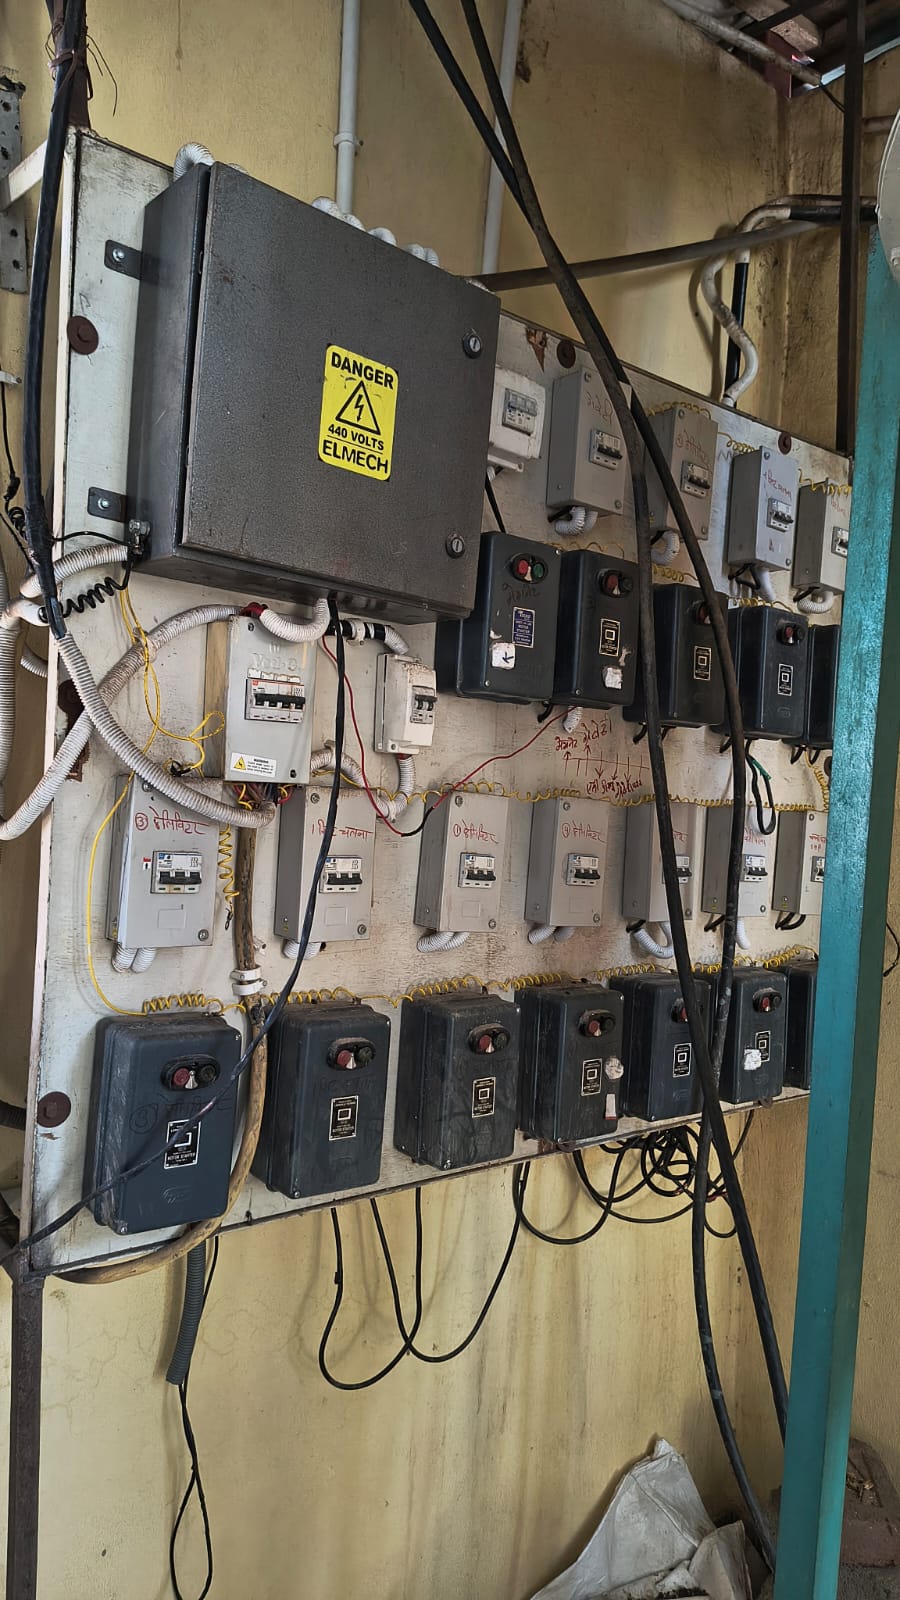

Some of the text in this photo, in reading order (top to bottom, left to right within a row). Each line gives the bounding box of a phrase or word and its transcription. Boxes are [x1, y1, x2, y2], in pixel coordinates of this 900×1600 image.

[331, 352, 394, 390] DANGER
[328, 423, 385, 451] 440 VOLTS
[322, 439, 389, 474] ELMECH
